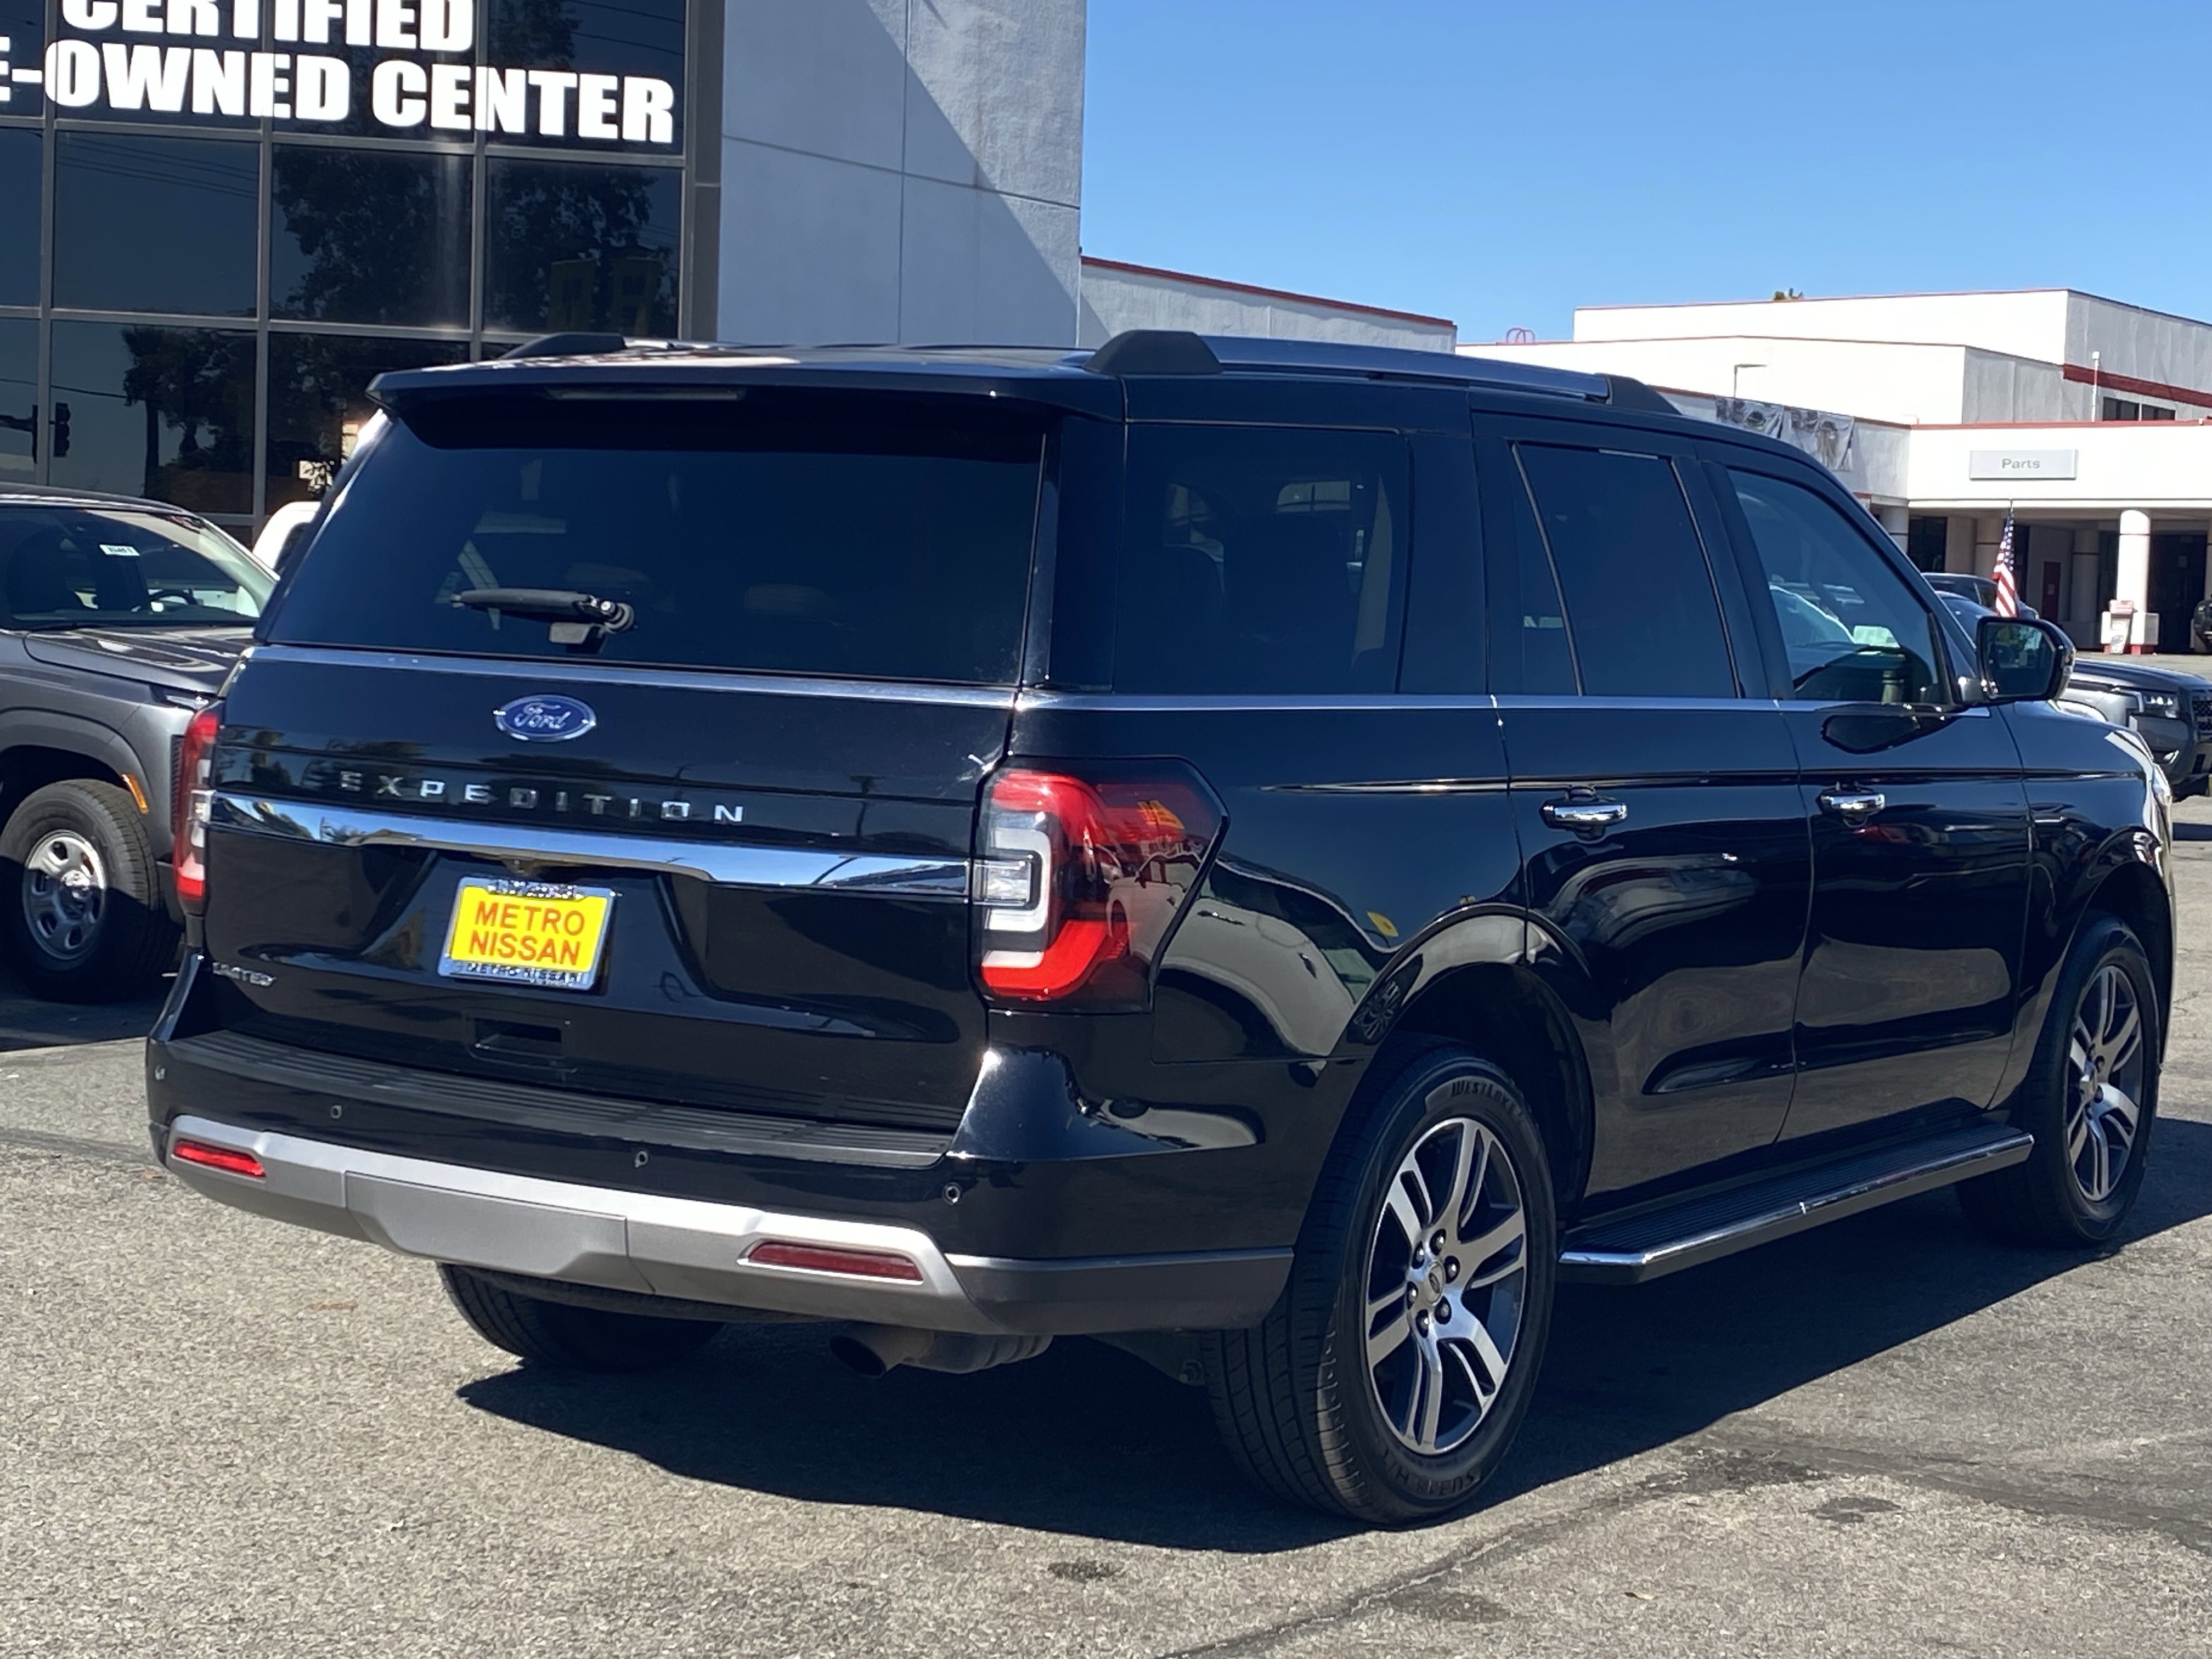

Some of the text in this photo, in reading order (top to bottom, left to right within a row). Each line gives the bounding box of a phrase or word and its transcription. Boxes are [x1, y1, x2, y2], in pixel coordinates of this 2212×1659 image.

[0, 36, 674, 143] -OWNED CENTER
[2002, 458, 2040, 469] Parts
[515, 703, 572, 729] Ford
[340, 771, 743, 822] EXPEDITION
[475, 900, 585, 936] METRO
[469, 929, 581, 966] NISSAN
